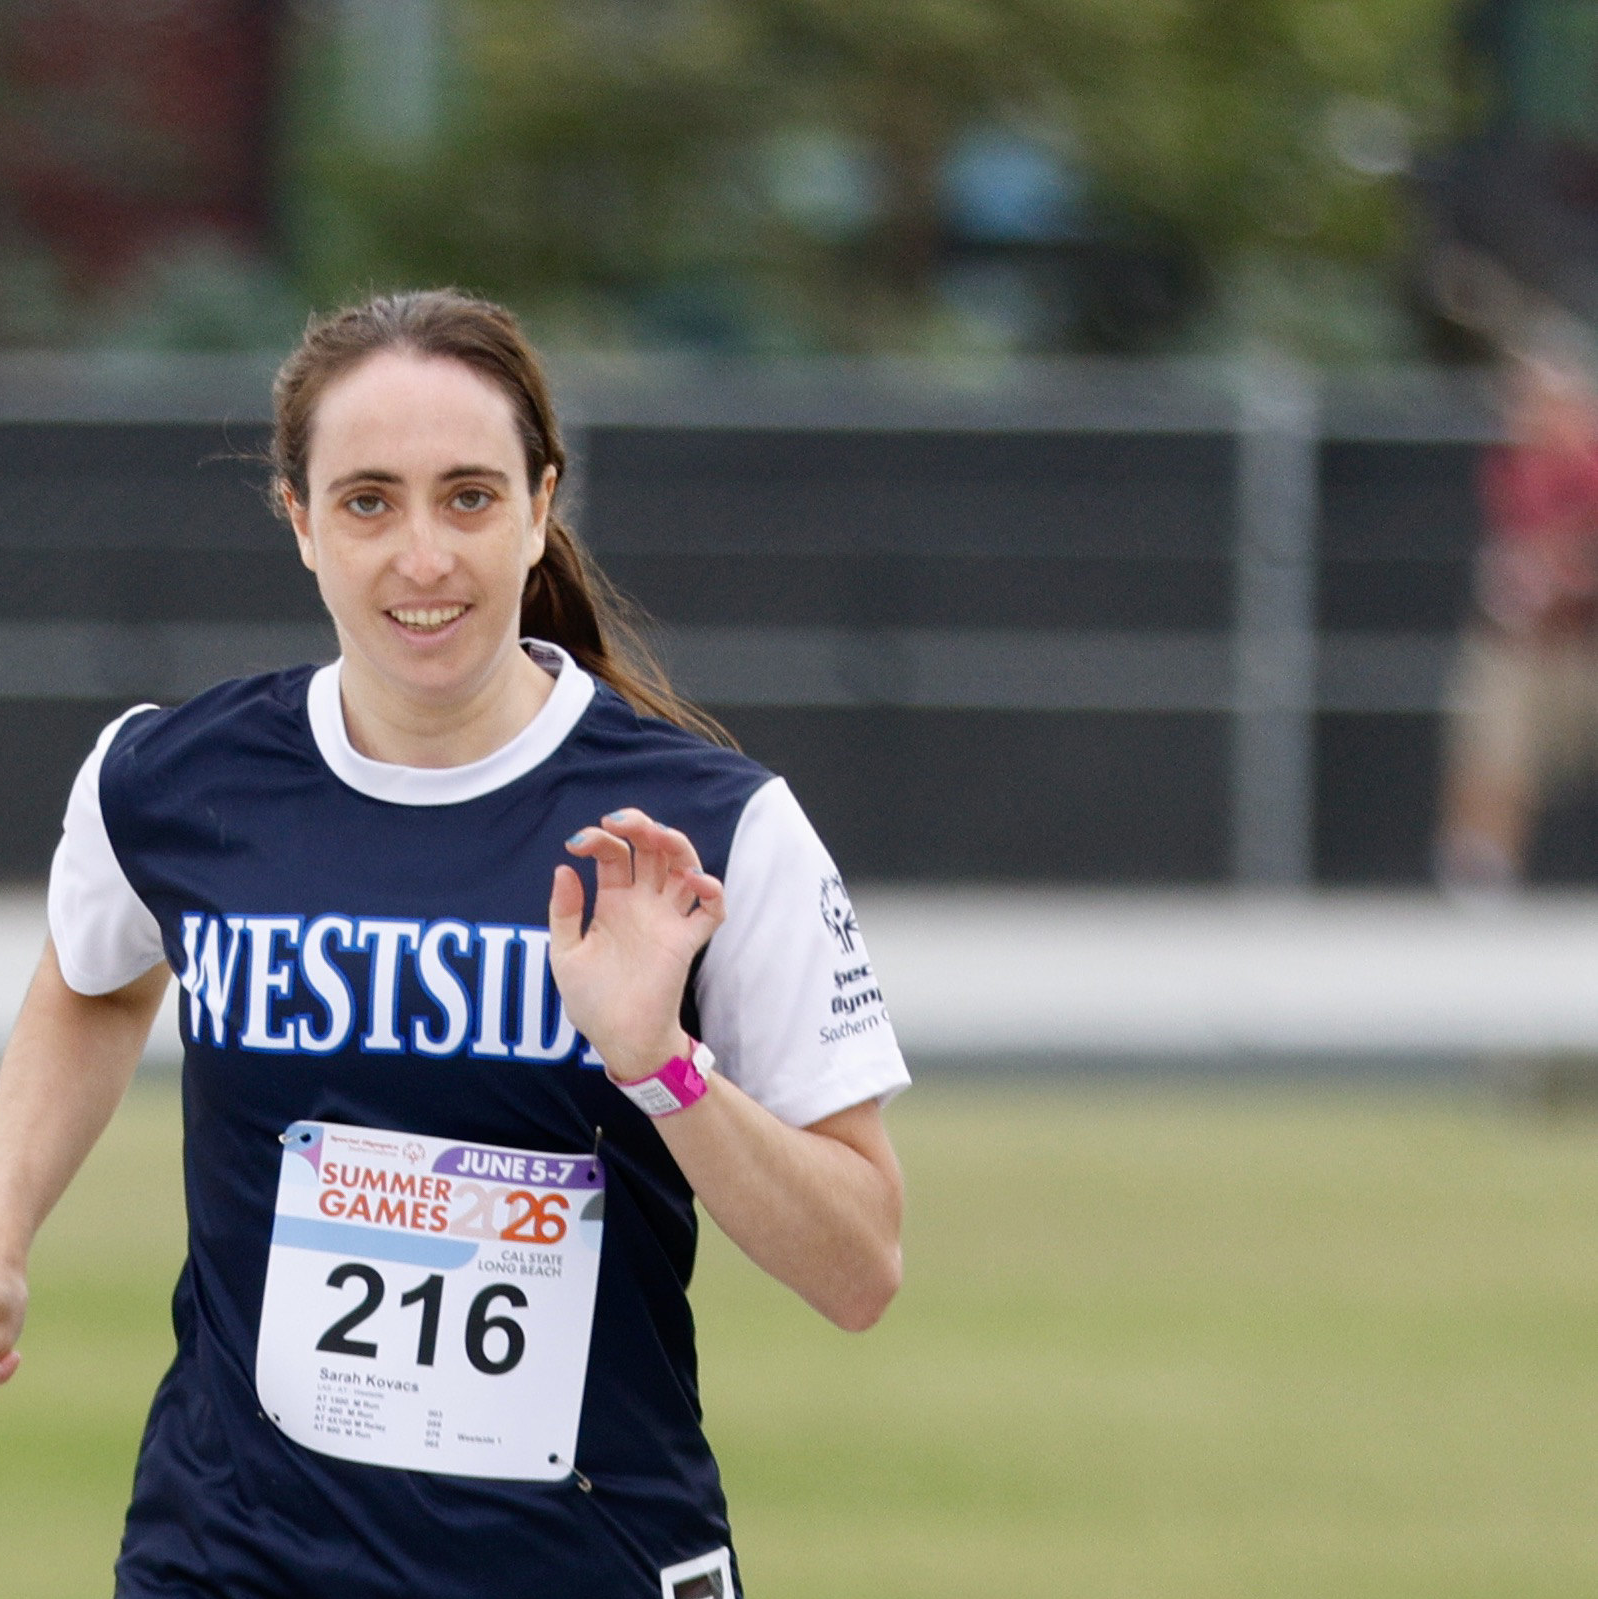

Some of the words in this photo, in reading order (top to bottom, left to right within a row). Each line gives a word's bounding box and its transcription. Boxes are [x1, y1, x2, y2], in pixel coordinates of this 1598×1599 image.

[180, 911, 606, 1068] WESTSID
[322, 1161, 452, 1204] SUMMER
[456, 1149, 527, 1182] JUNE
[529, 1159, 576, 1186] 5-7
[318, 1188, 449, 1233] GAMES
[449, 1182, 571, 1245] 2026
[477, 1260, 517, 1276] LONG
[519, 1263, 563, 1279] BEACH
[501, 1249, 525, 1262] CAL
[528, 1252, 563, 1266] STATE
[315, 1262, 529, 1376] 216
[319, 1366, 362, 1385] Sarah
[365, 1373, 420, 1393] Kovacs
